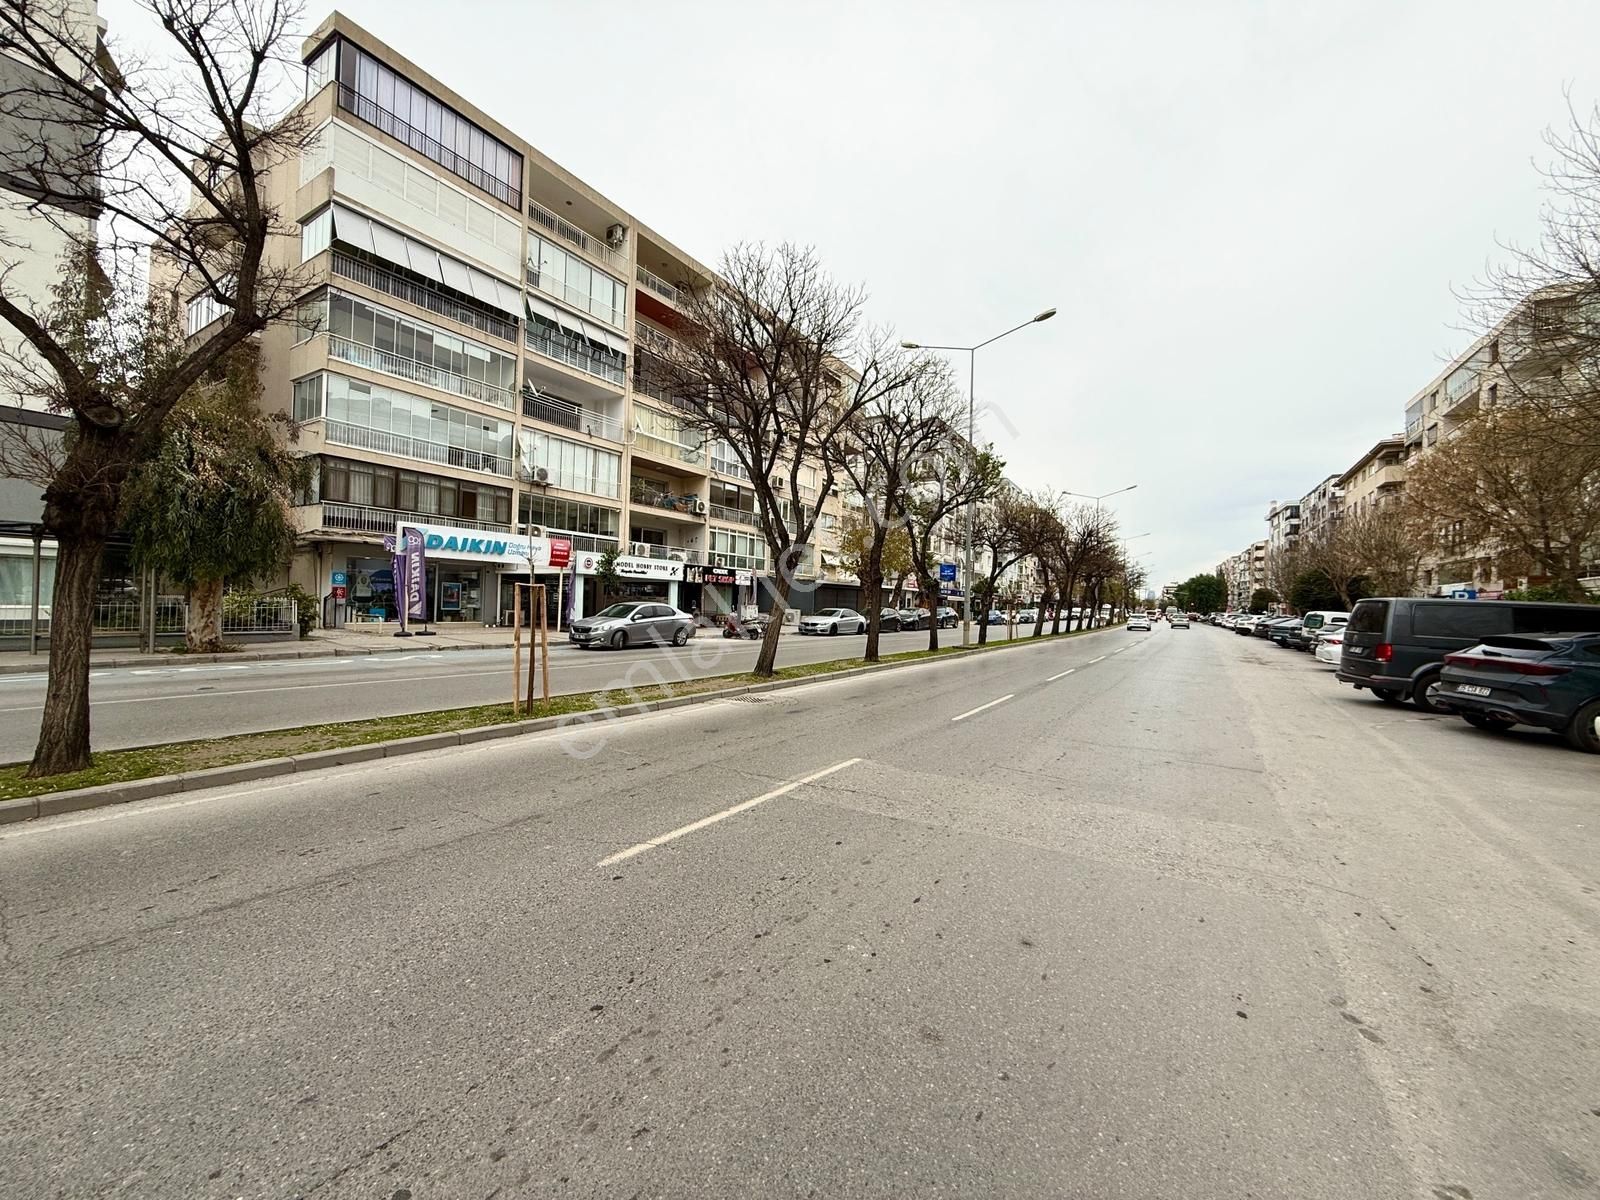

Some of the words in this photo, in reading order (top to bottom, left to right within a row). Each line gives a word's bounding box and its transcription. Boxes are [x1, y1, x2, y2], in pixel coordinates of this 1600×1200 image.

[425, 533, 508, 556] DAIKIN
[615, 561, 634, 569] MODEL
[410, 551, 420, 602] DAIKIN
[704, 574, 717, 582] PET
[718, 575, 735, 583] SHOP
